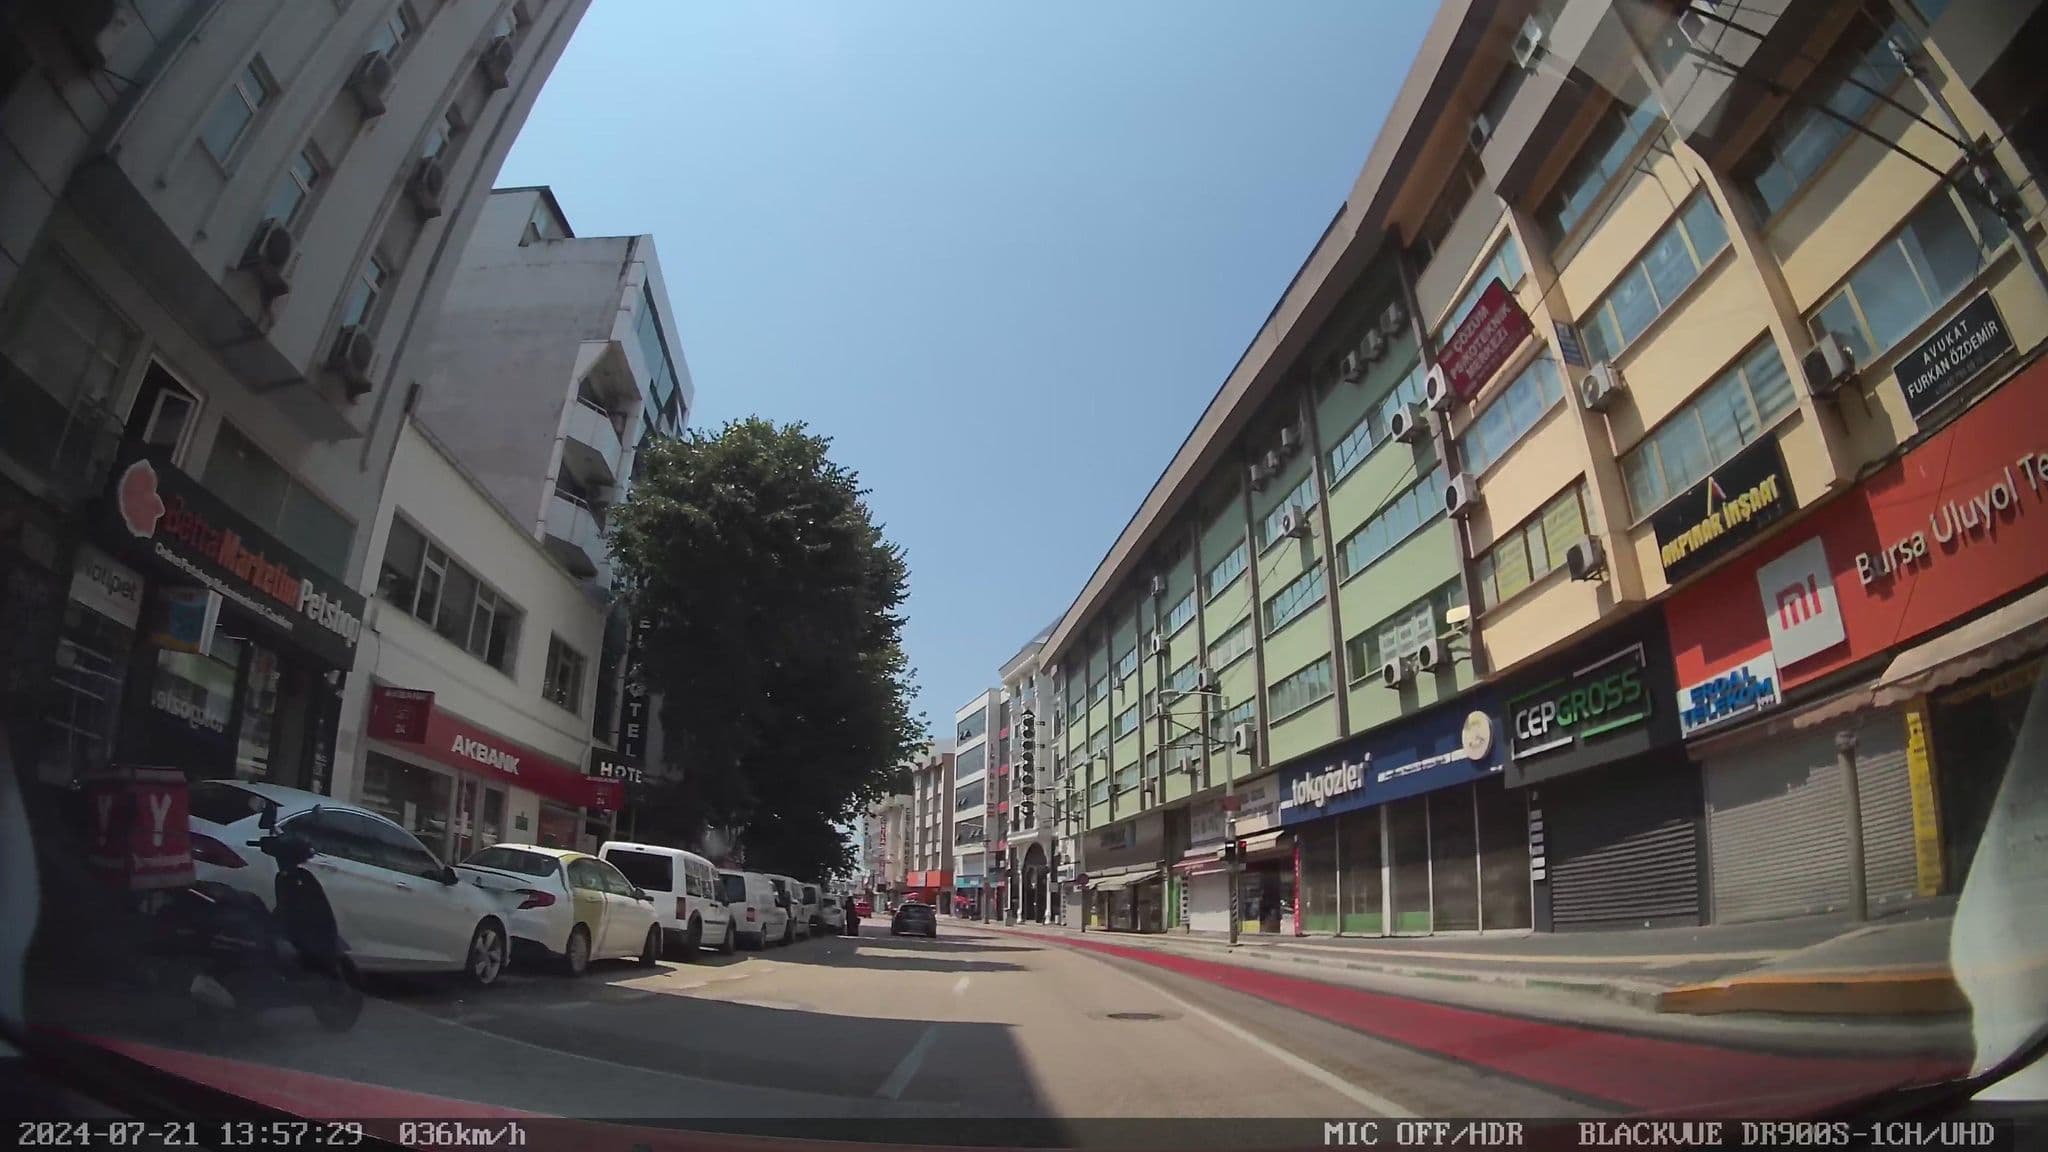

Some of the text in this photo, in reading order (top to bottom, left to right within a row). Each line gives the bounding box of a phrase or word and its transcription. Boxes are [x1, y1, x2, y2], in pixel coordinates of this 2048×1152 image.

[1906, 357, 1951, 399] FURKAN
[1949, 319, 1999, 366] ÖZDEMİR
[1922, 320, 1968, 366] AVUKAT
[1855, 530, 1927, 586] Bursa
[1929, 466, 2019, 543] Uluyol
[450, 733, 521, 775] AKBANK
